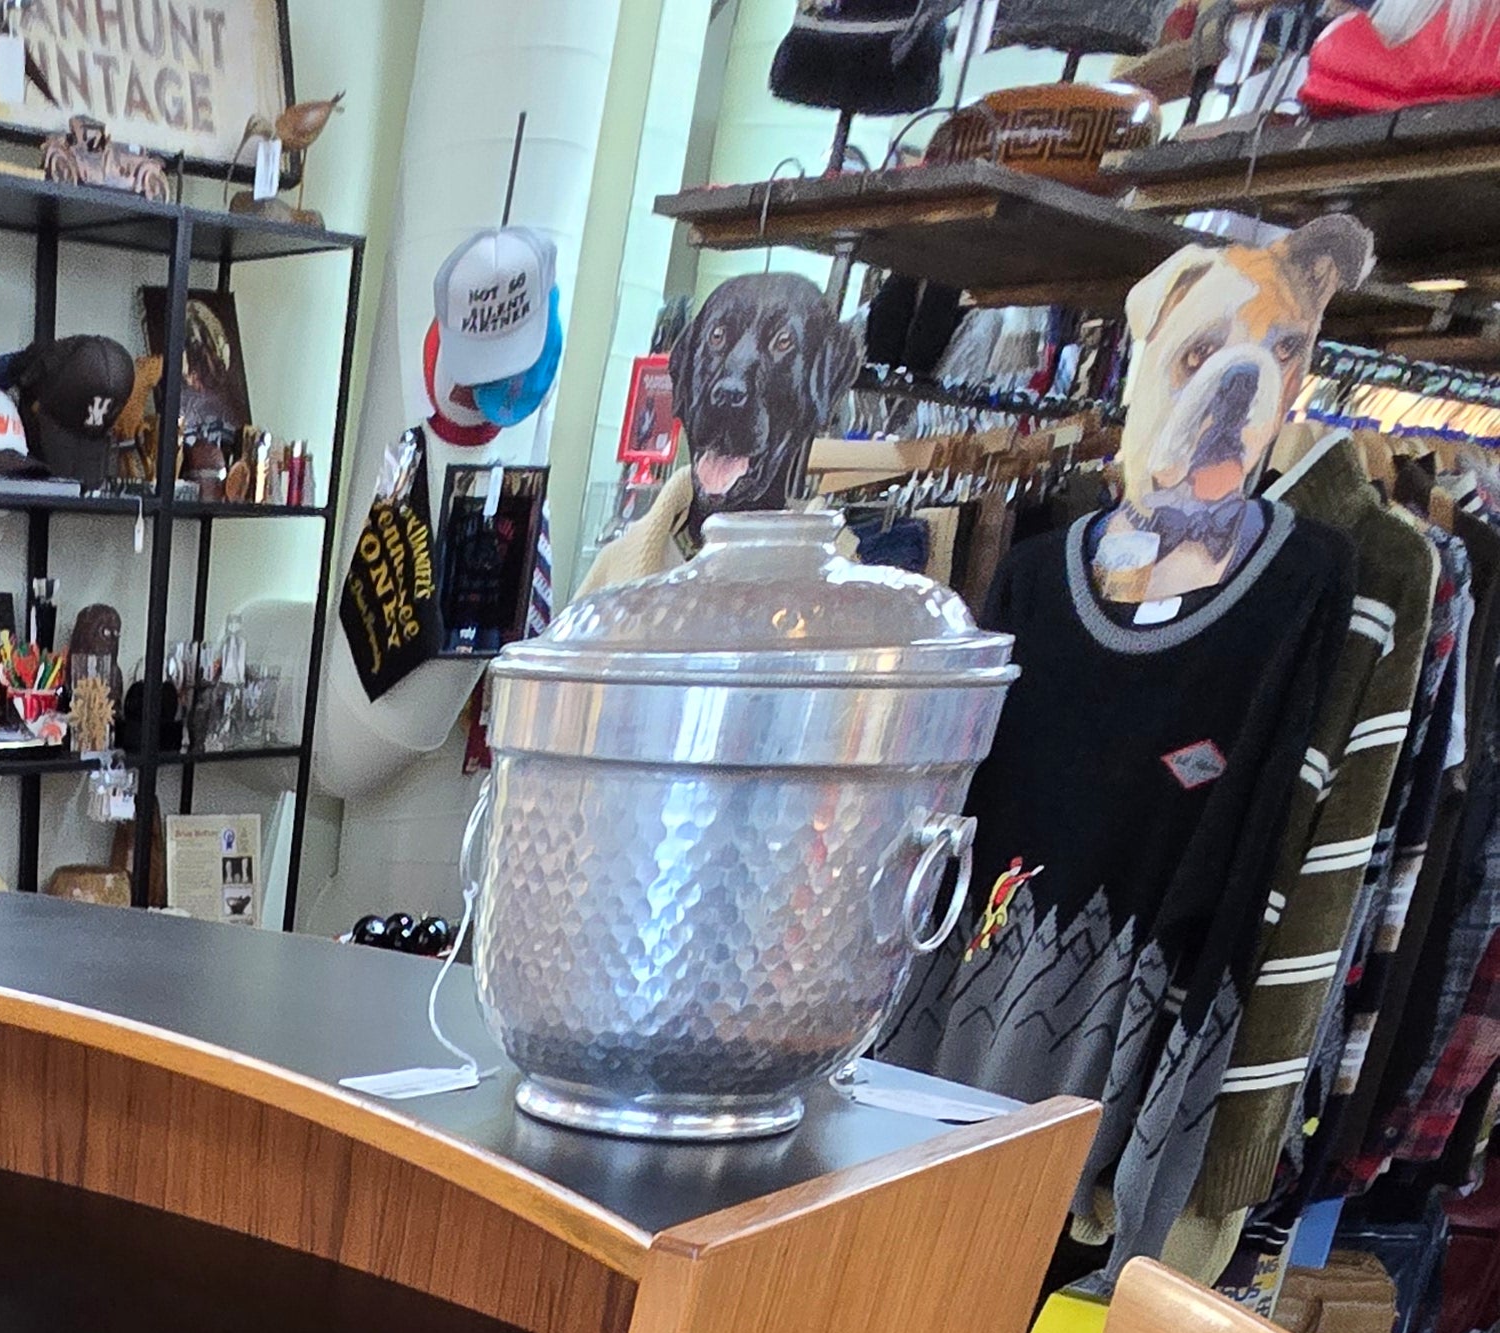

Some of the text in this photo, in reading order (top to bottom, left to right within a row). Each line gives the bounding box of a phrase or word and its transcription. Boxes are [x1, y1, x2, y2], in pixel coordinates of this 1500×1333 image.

[18, 0, 226, 72] ANHUNT
[24, 38, 216, 135] INTAGE
[360, 532, 401, 650] ONEY
